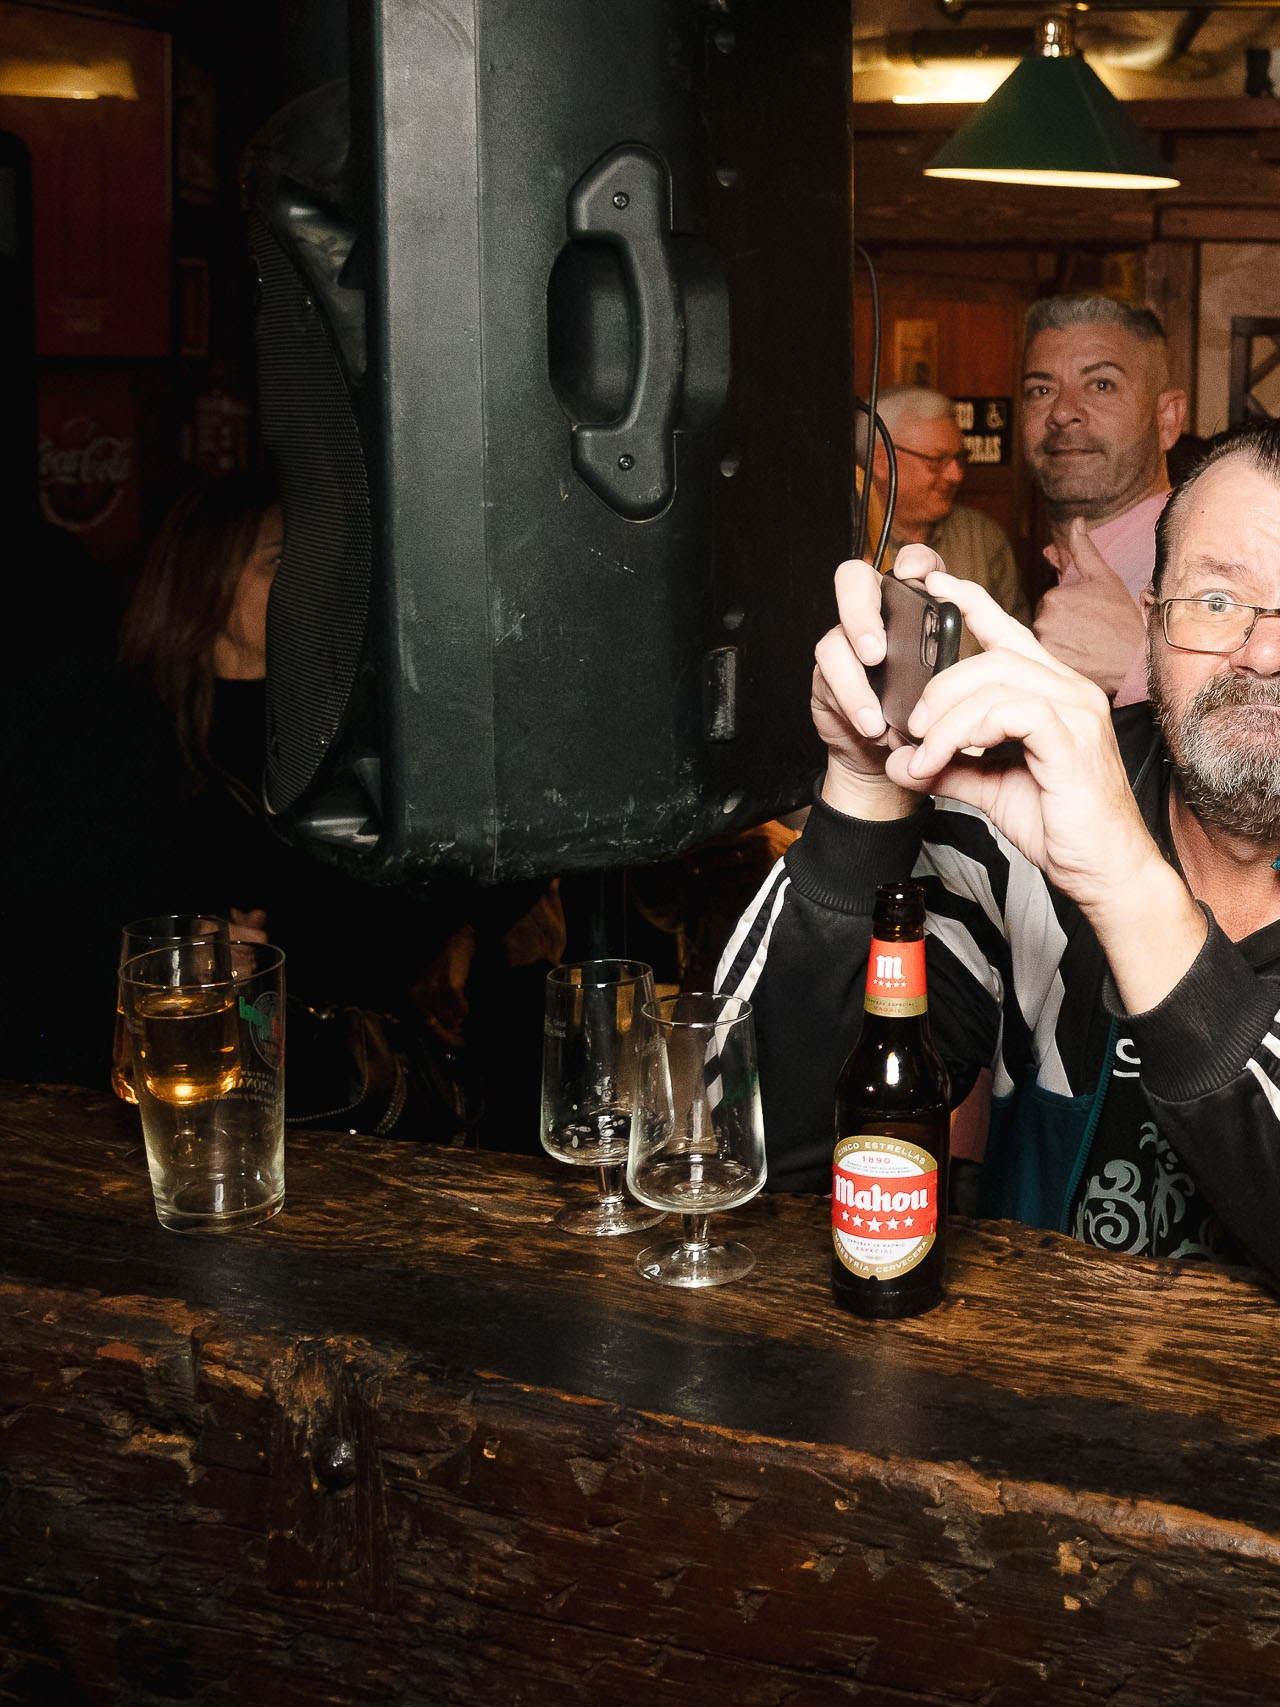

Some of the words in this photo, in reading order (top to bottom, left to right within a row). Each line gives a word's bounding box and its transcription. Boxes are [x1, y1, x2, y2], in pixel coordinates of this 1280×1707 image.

[837, 1142, 860, 1157] CINCO
[864, 1141, 926, 1165] ESTRELLAS
[862, 1155, 891, 1165] 1890
[835, 1174, 929, 1213] Mahou
[875, 1241, 928, 1273] CERVECERA
